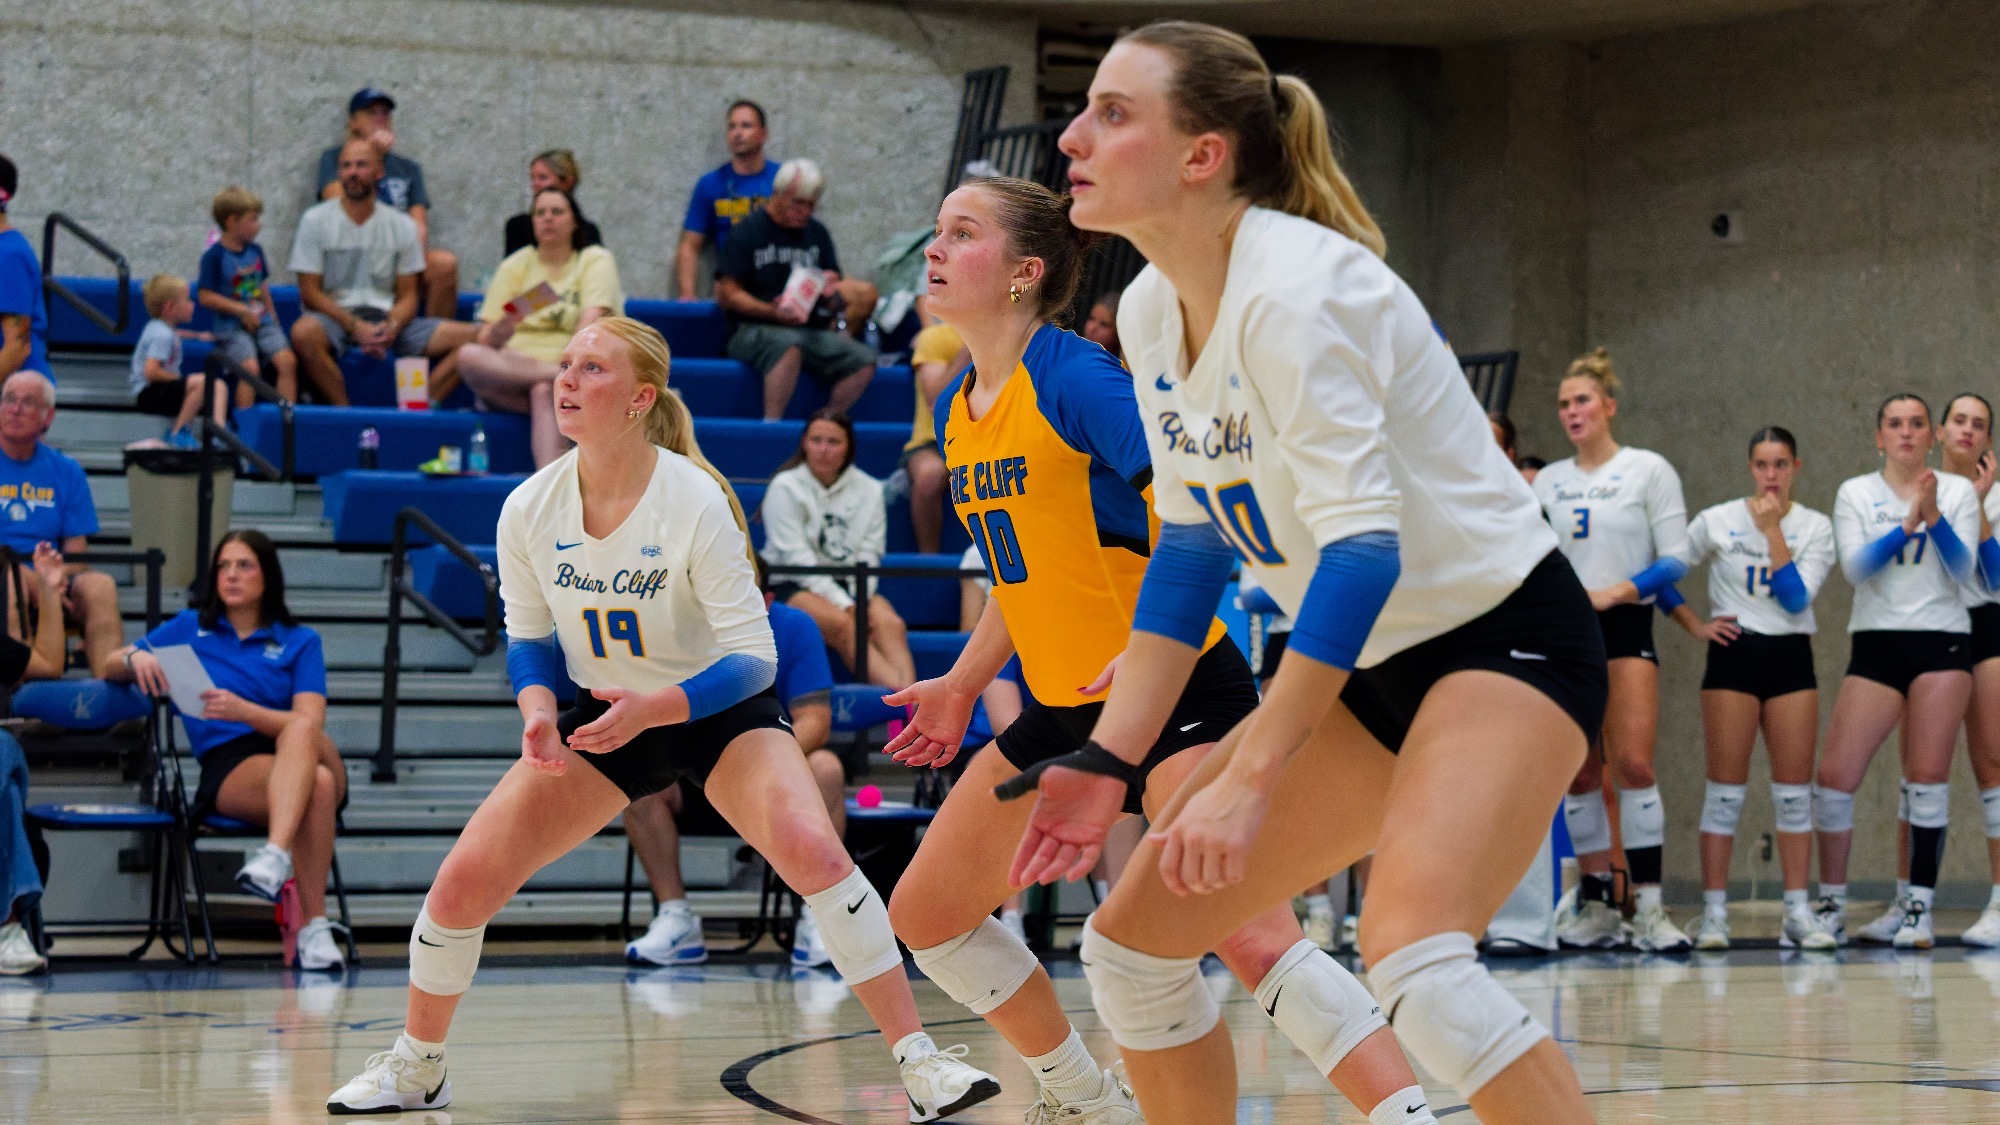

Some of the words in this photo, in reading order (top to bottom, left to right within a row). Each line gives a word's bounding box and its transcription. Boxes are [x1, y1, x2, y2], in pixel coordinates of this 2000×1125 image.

[973, 456, 1028, 501] CLIFF
[1571, 507, 1591, 540] 3
[966, 508, 1028, 586] 10
[554, 563, 607, 593] Briar
[612, 569, 668, 600] Cliff
[582, 607, 647, 660] 19
